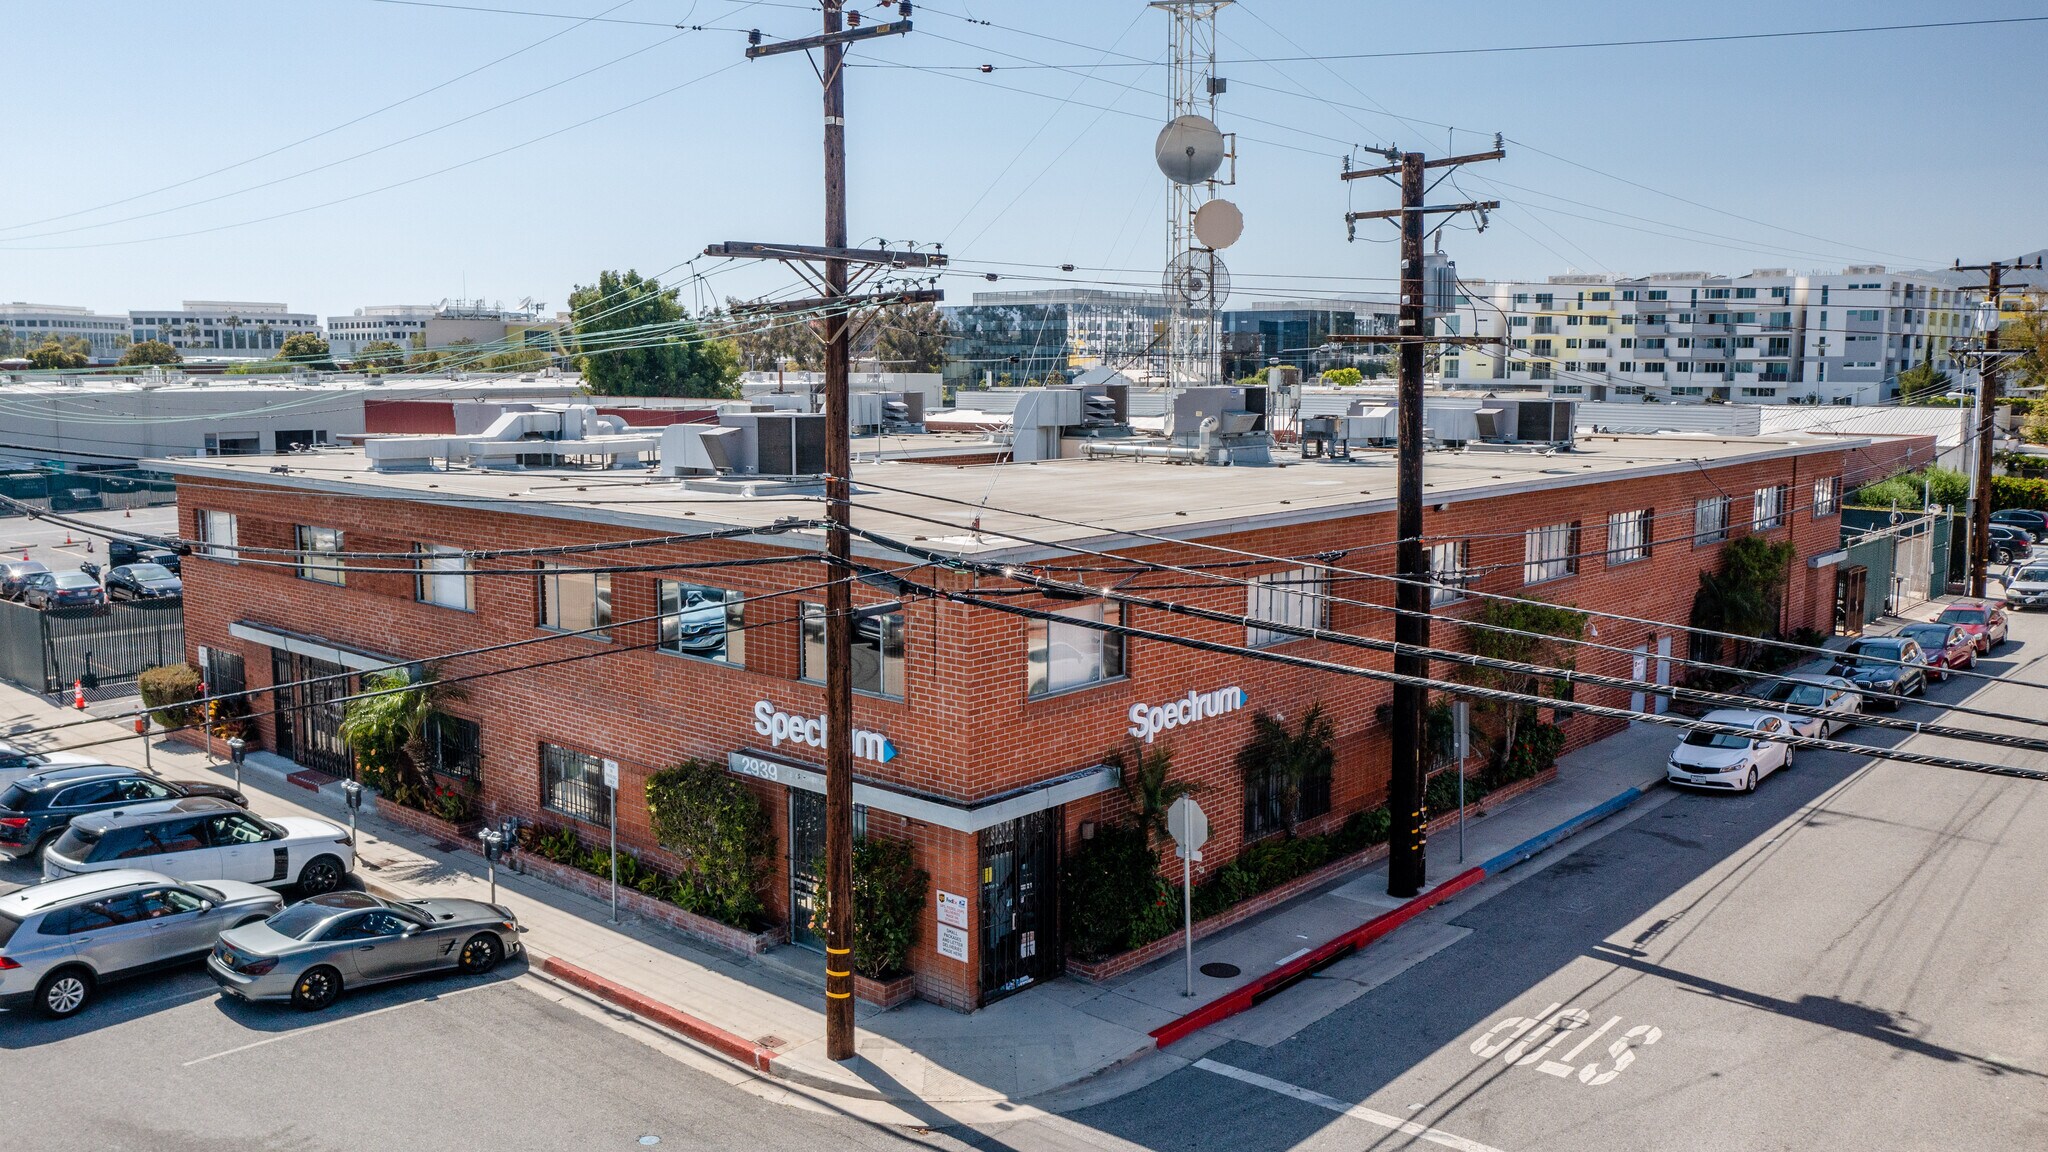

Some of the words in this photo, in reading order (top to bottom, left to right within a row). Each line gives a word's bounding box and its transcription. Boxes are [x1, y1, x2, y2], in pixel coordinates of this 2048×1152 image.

[754, 700, 887, 763] Spectm
[1128, 686, 1241, 744] Spectrum
[741, 757, 778, 781] 2939
[1470, 1002, 1663, 1086] STOP
